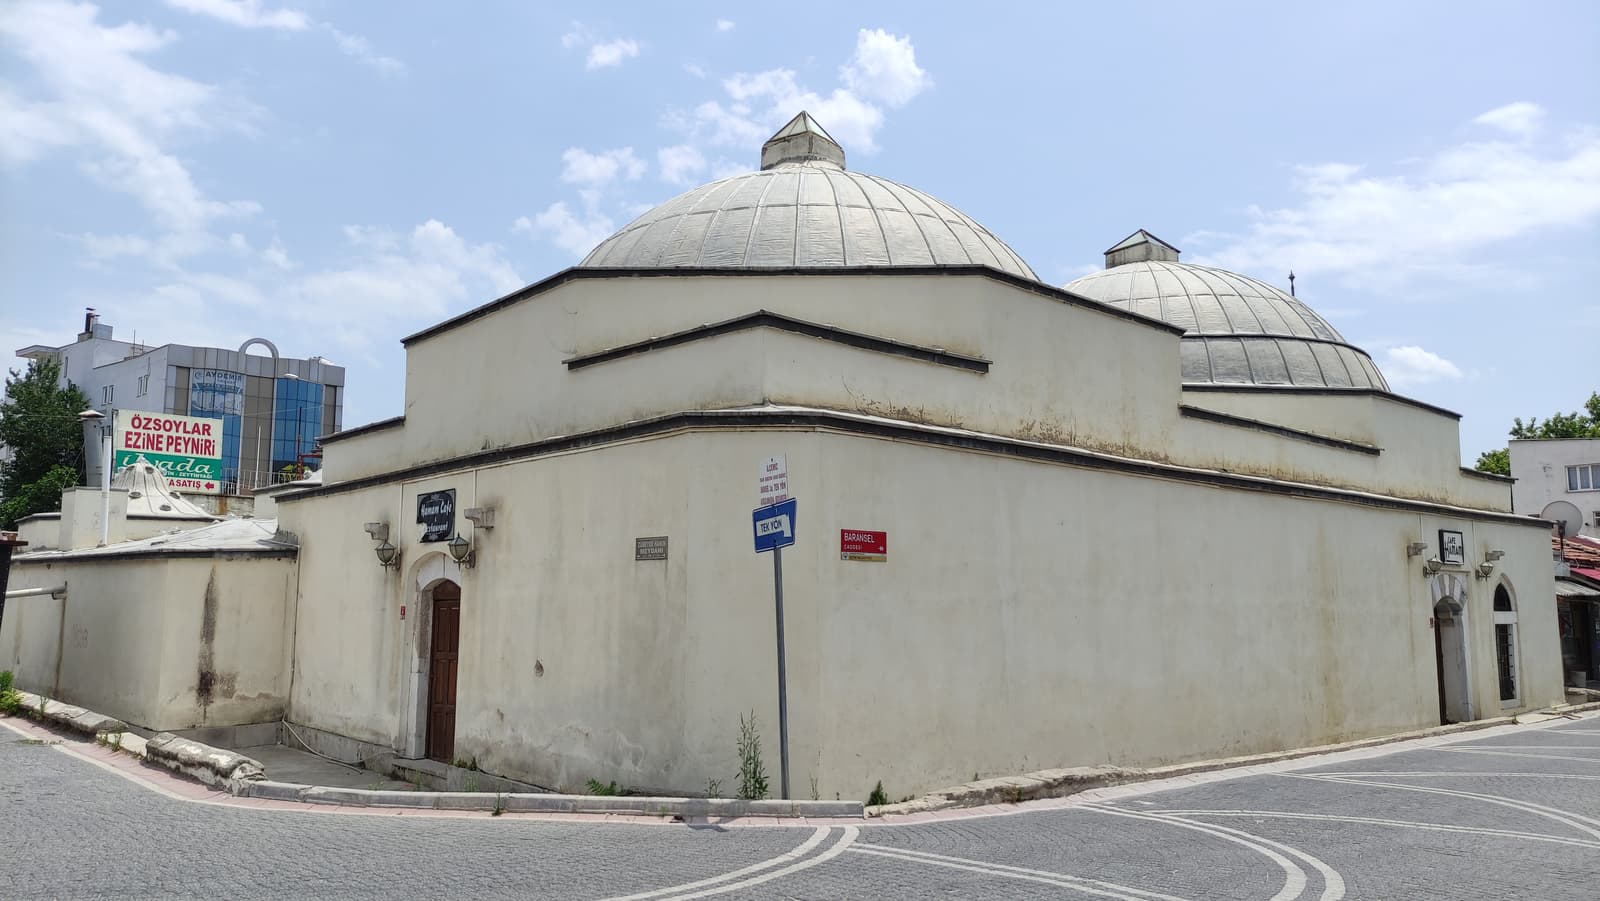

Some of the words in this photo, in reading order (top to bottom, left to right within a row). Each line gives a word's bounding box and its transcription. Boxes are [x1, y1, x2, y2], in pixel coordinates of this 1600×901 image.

[131, 413, 212, 437] ÖZSOYLAR
[760, 522, 770, 534] TEK
[771, 518, 782, 531] YÖN
[844, 532, 875, 543] BARANSEL
